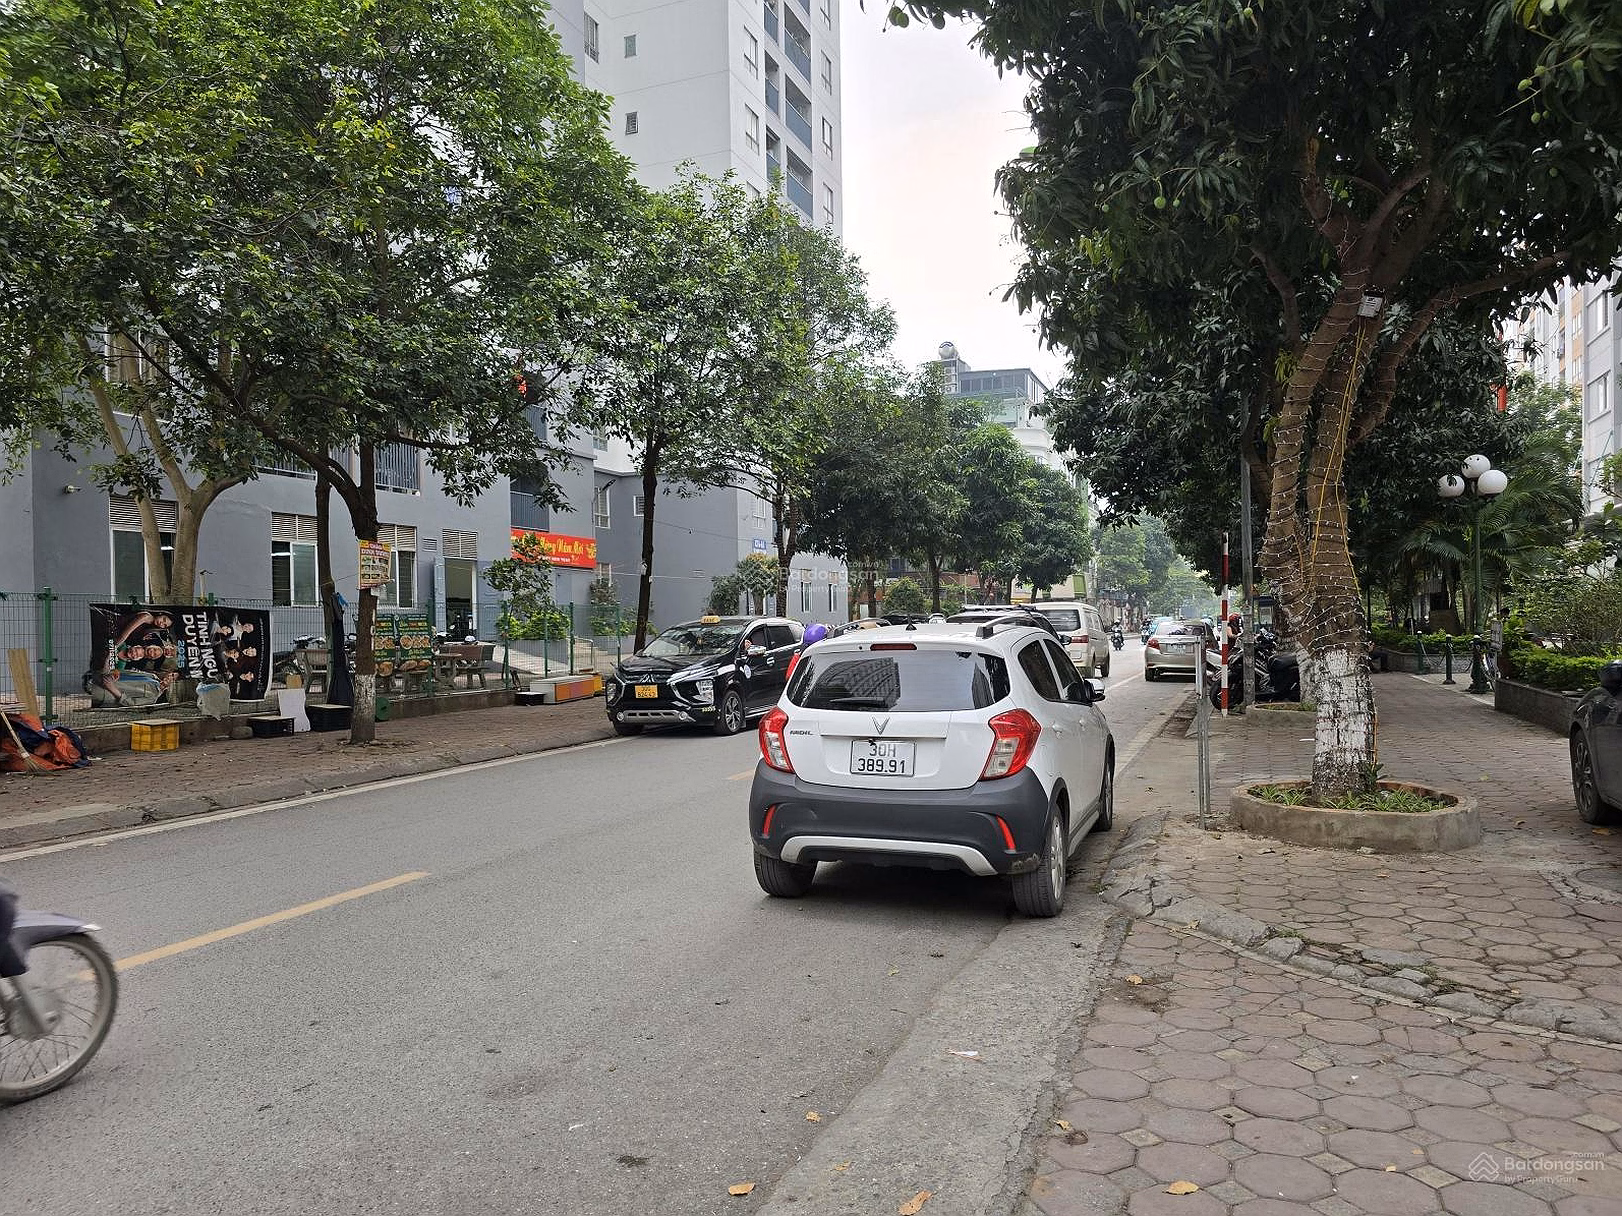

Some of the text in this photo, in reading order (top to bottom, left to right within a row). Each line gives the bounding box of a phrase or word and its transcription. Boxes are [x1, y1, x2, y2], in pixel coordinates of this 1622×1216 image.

[177, 639, 185, 668] 2025
[869, 743, 896, 758] 30H
[857, 758, 906, 774] 389.91
